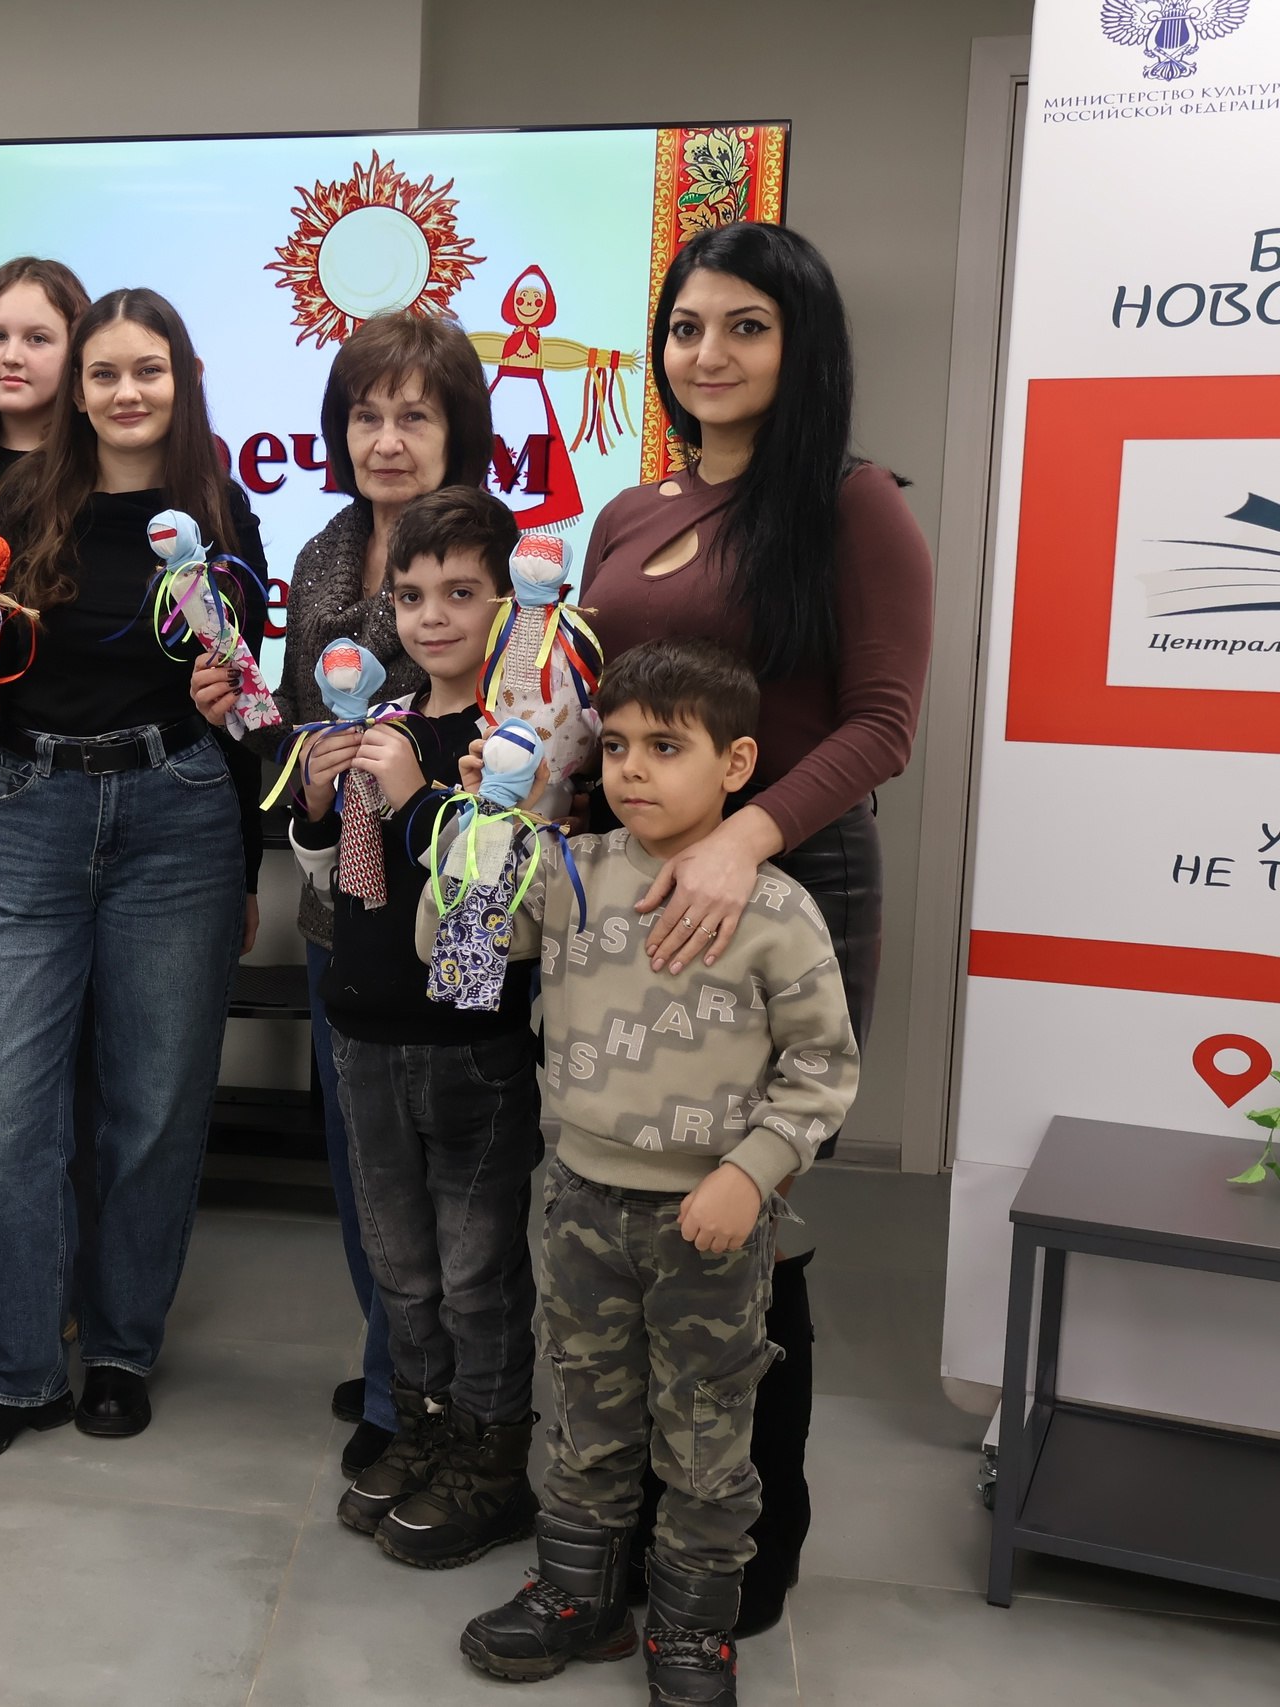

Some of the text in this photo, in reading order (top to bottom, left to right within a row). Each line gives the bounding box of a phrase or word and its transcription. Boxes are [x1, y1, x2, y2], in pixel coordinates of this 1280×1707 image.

[1044, 88, 1195, 108] МИНИСТЕРСТВО
[1043, 98, 1280, 124] РОССИЙСКОЙ ФЕДЕРАЦИ
[1148, 633, 1280, 656] Централ
[1172, 854, 1236, 887] НЕ
